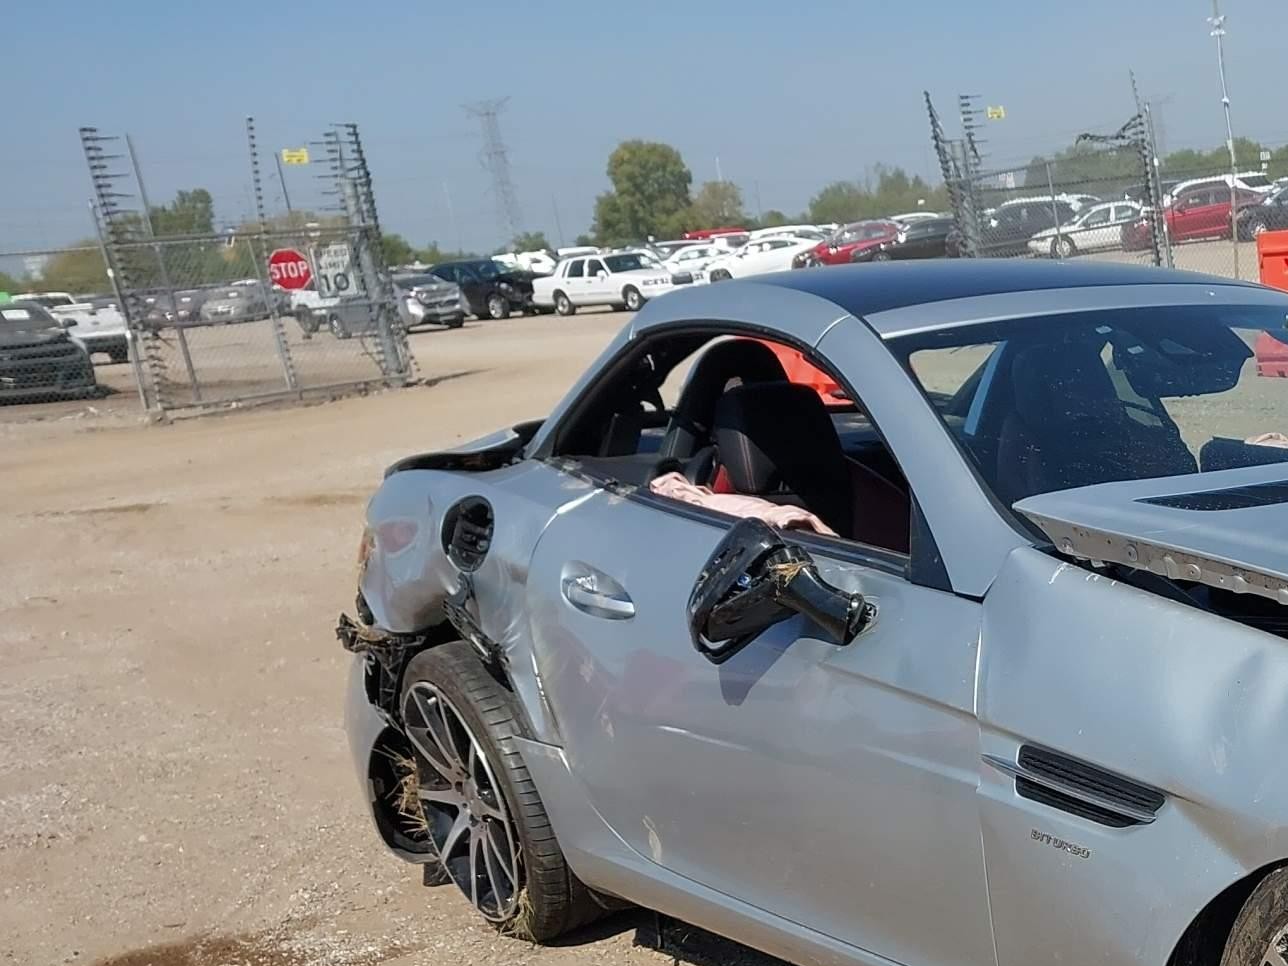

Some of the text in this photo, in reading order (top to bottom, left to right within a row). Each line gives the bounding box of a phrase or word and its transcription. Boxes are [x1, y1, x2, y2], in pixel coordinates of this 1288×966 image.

[269, 260, 308, 280] STOP
[321, 273, 350, 292] 10
[1030, 828, 1091, 859] BITURBO
